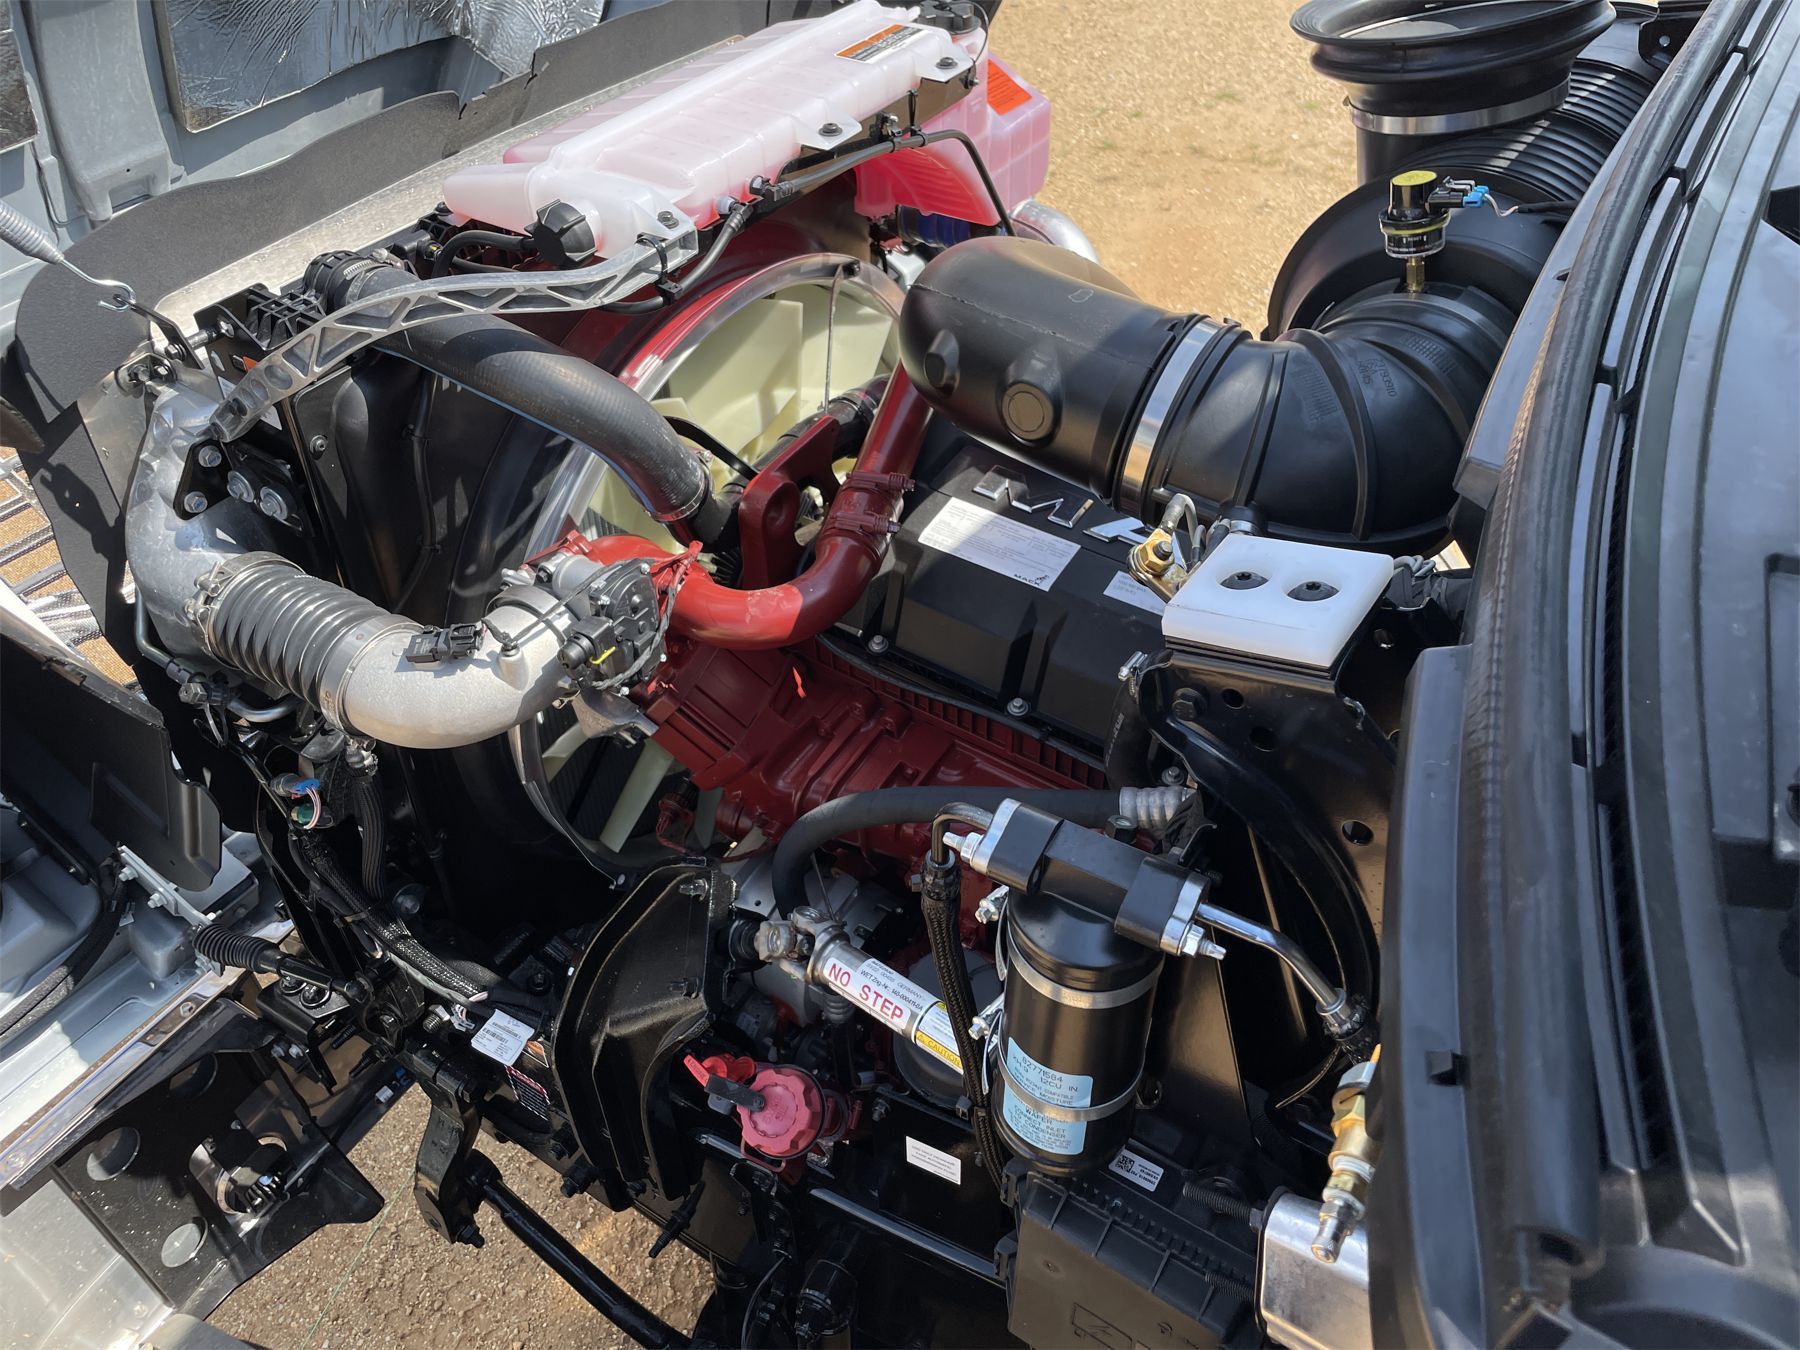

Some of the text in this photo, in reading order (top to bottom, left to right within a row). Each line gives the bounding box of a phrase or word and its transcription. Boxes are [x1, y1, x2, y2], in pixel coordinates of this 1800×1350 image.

[1014, 574, 1040, 587] MACK
[829, 963, 851, 987] NO
[860, 984, 903, 1020] STEP
[928, 1040, 960, 1067] CAUTION
